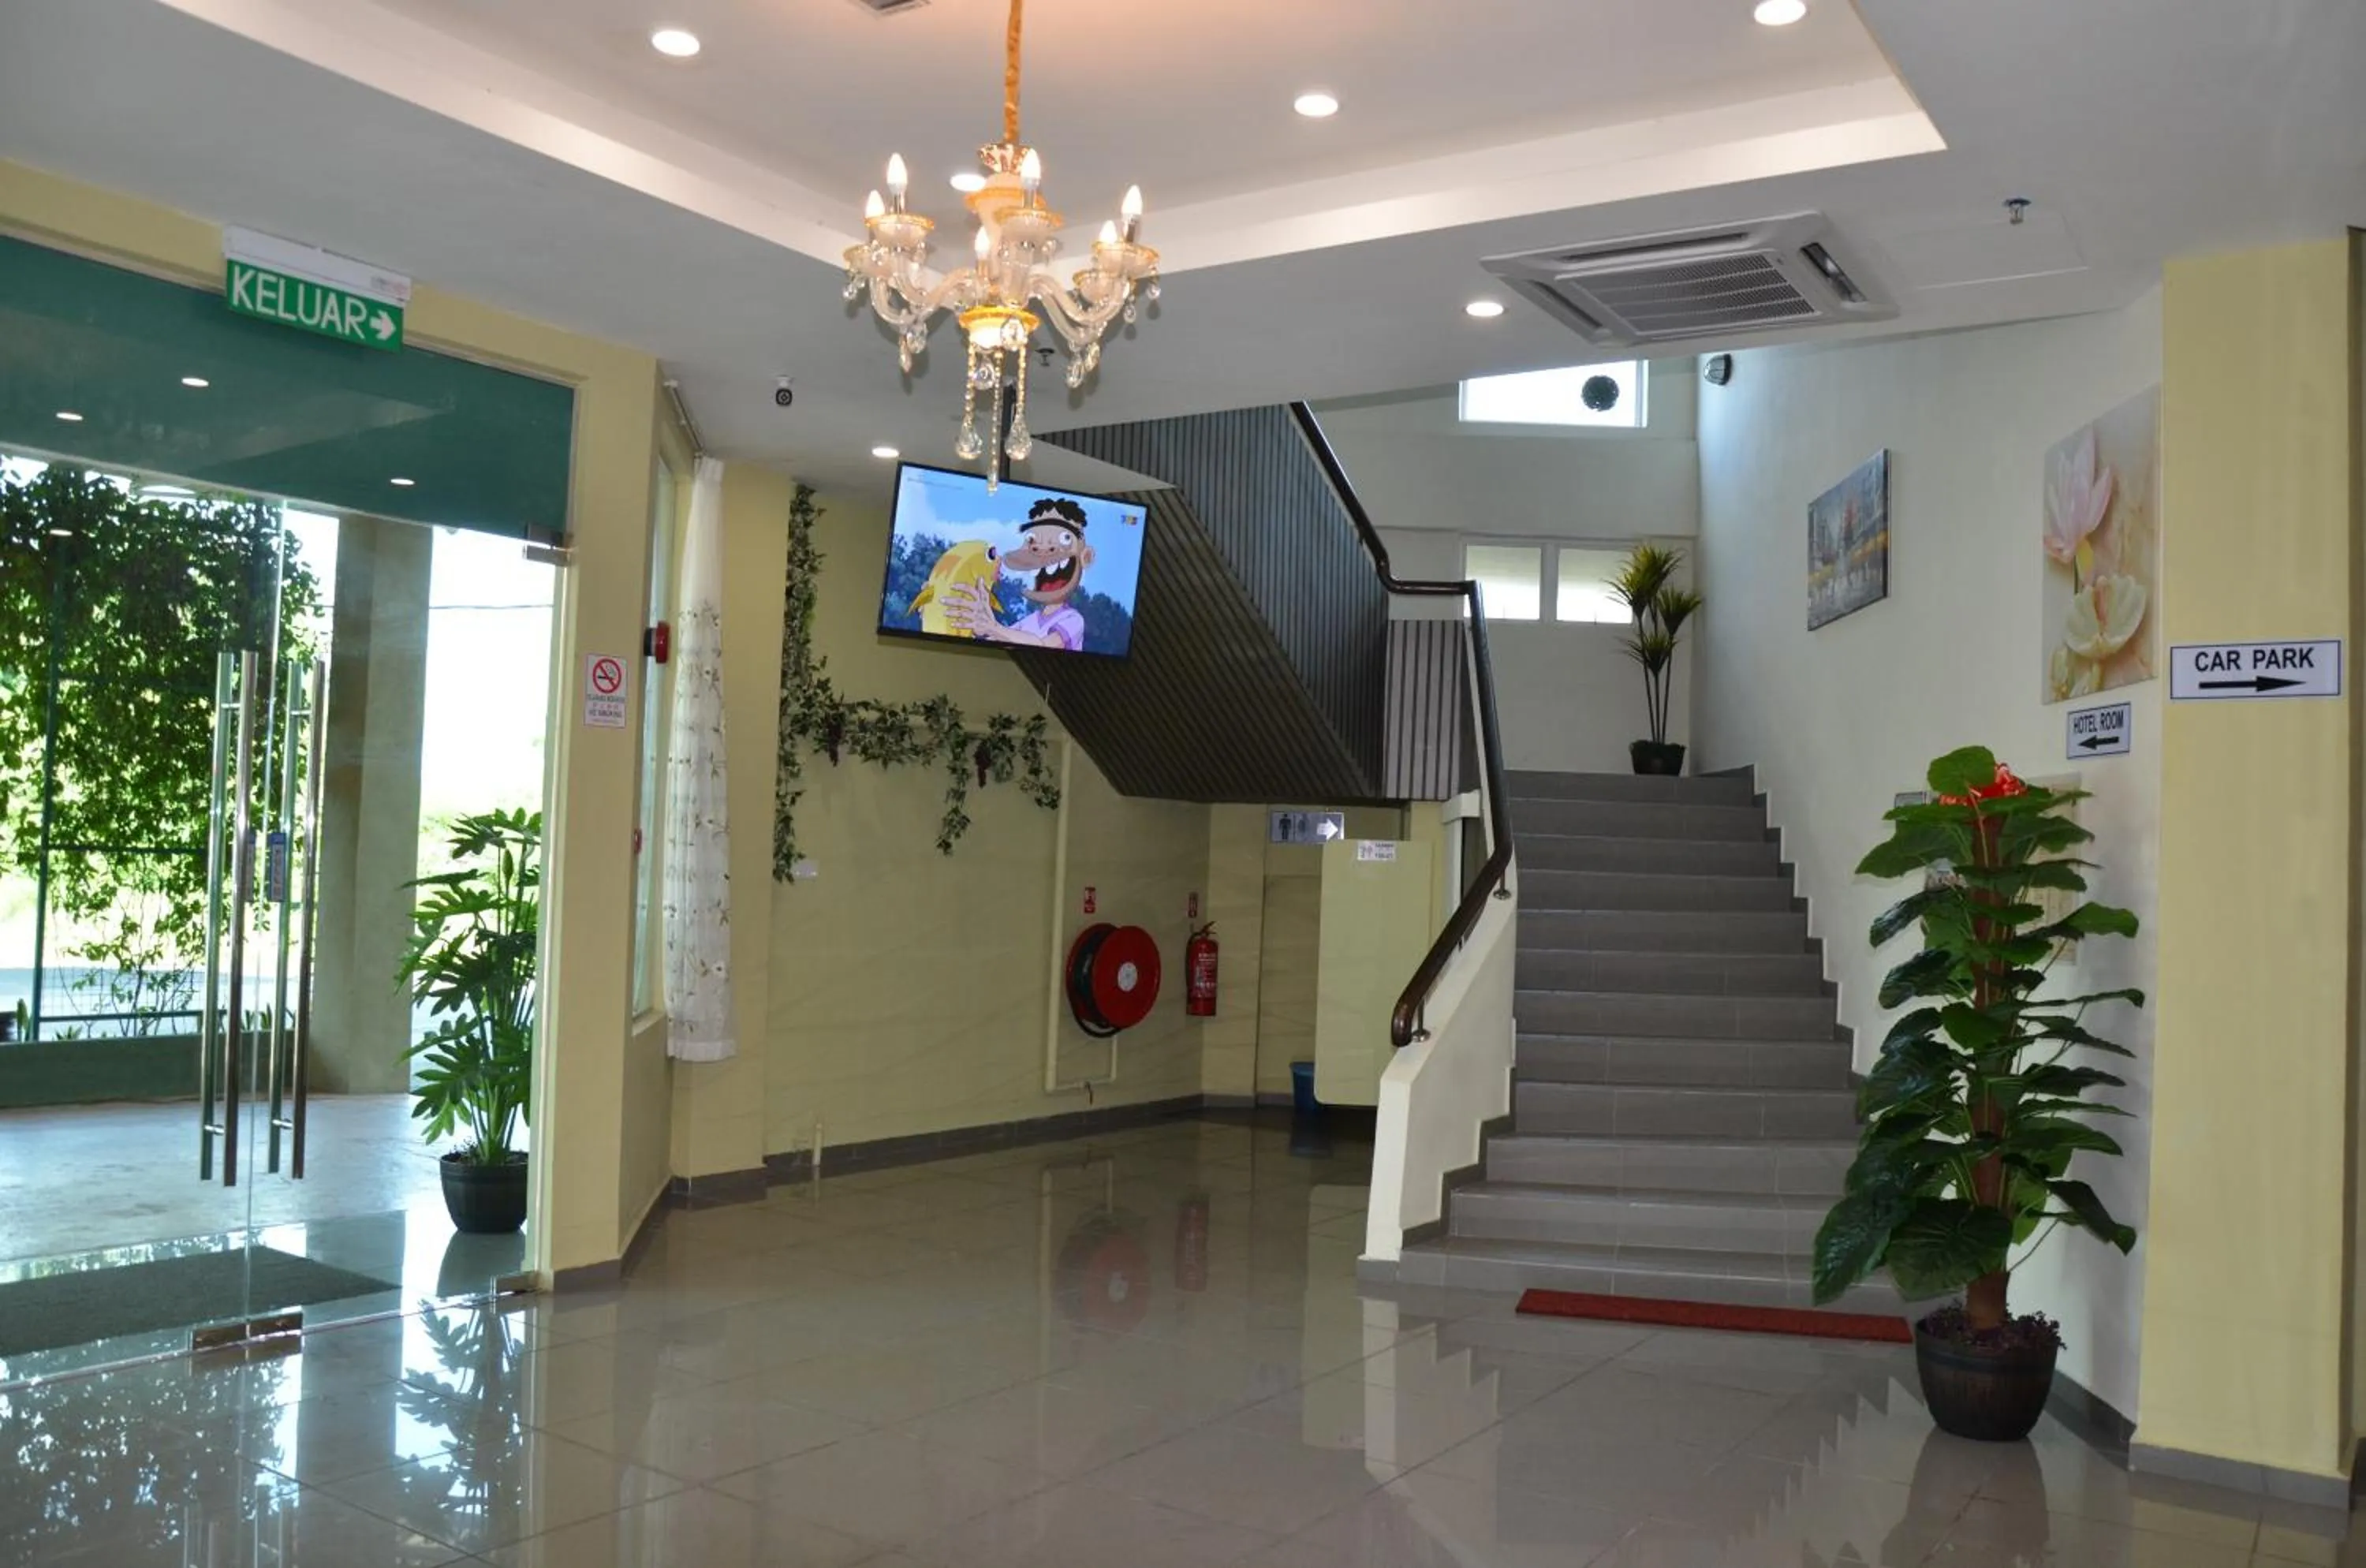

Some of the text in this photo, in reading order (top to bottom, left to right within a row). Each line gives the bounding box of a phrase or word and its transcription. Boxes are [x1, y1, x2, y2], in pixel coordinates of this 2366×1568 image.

[233, 264, 367, 339] KELUAR
[2195, 647, 2314, 672] CAR PARK
[2073, 709, 2124, 734] HOTEL ROOM
